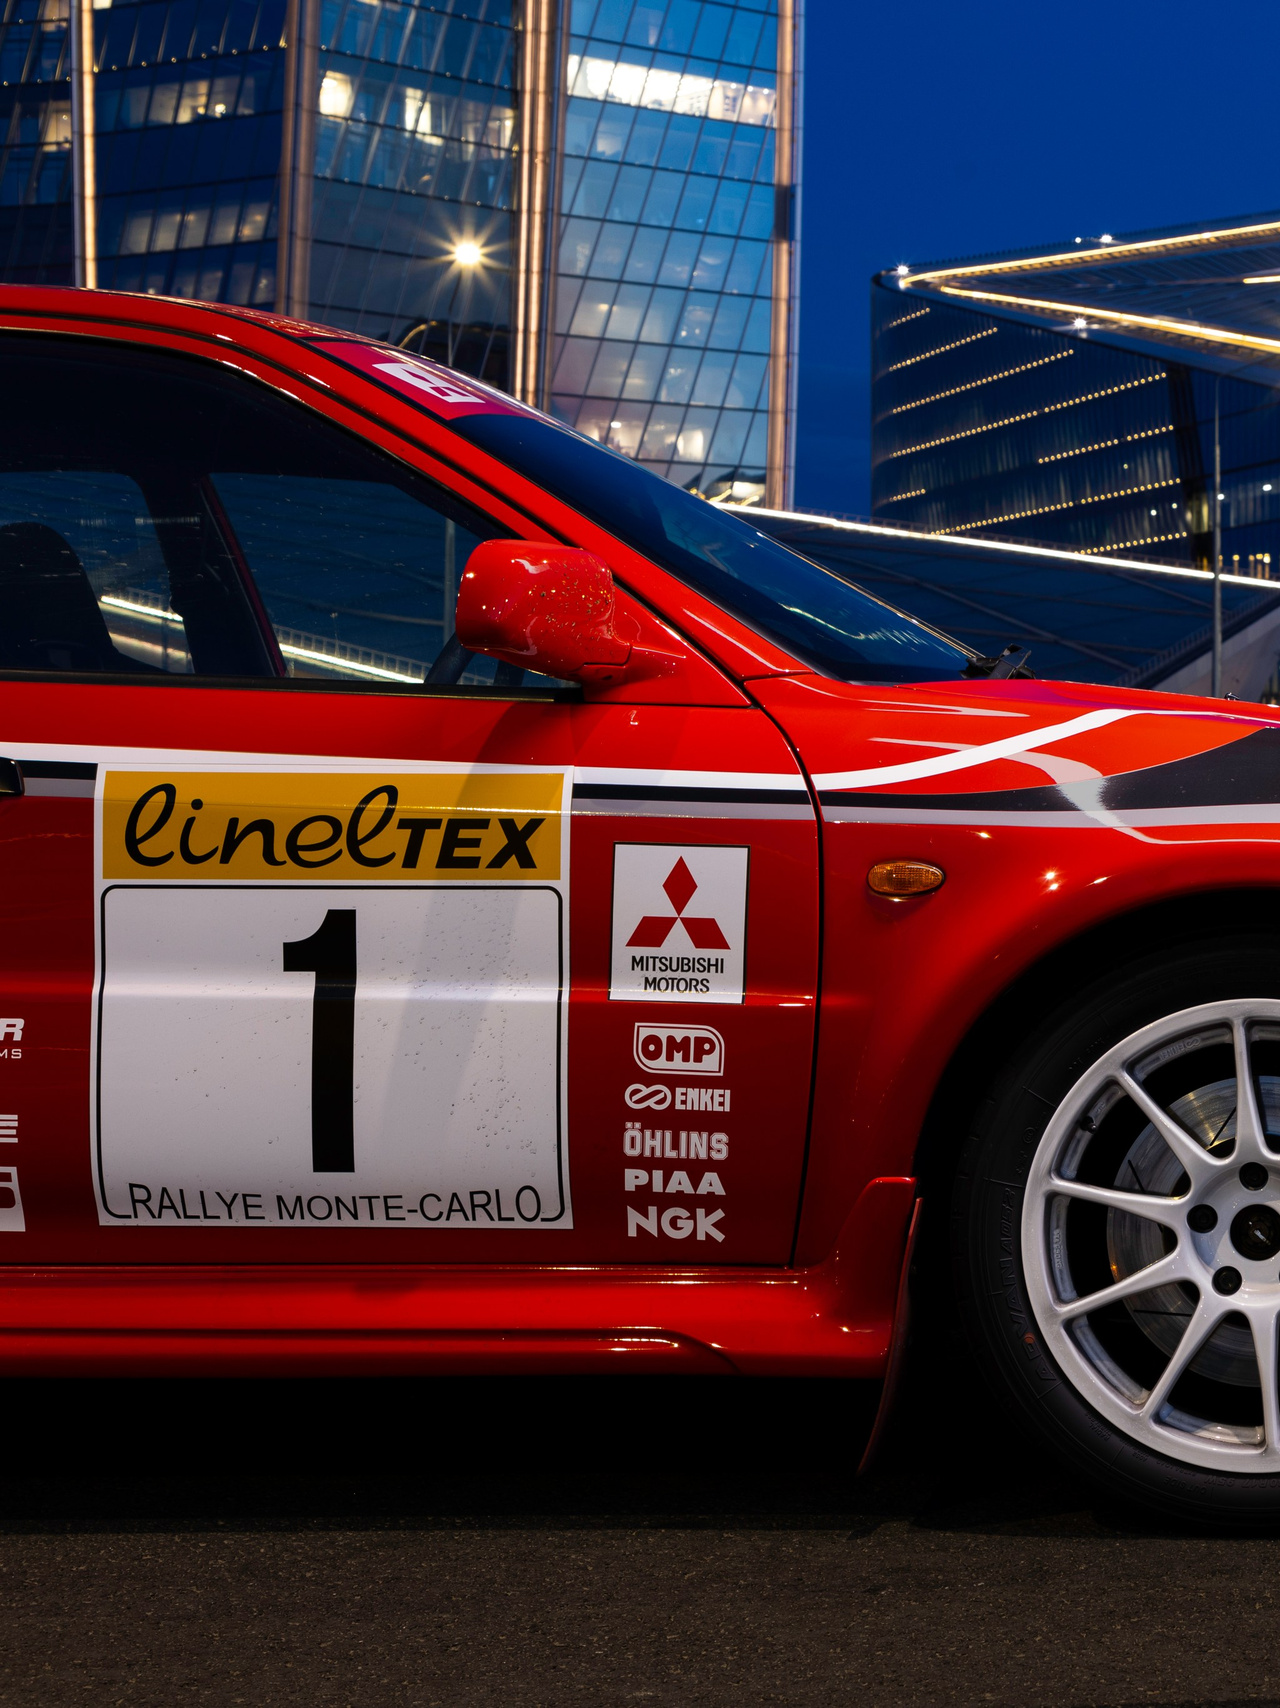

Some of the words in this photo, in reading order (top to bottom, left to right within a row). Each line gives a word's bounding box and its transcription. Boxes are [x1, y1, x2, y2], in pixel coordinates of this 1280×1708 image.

[630, 955, 725, 974] MITSUBISHI
[643, 976, 710, 994] MOTORS
[282, 908, 357, 1173] 1
[640, 1033, 717, 1064] OMP
[674, 1088, 731, 1112] ENKEI
[623, 1122, 729, 1161] ÖHLINS
[624, 1168, 726, 1196] PIAA
[128, 1182, 264, 1220] RALLYE
[276, 1184, 542, 1223] MONTE-CARLO
[626, 1205, 726, 1243] NGK
[1000, 1257, 1057, 1381] ADVAN
